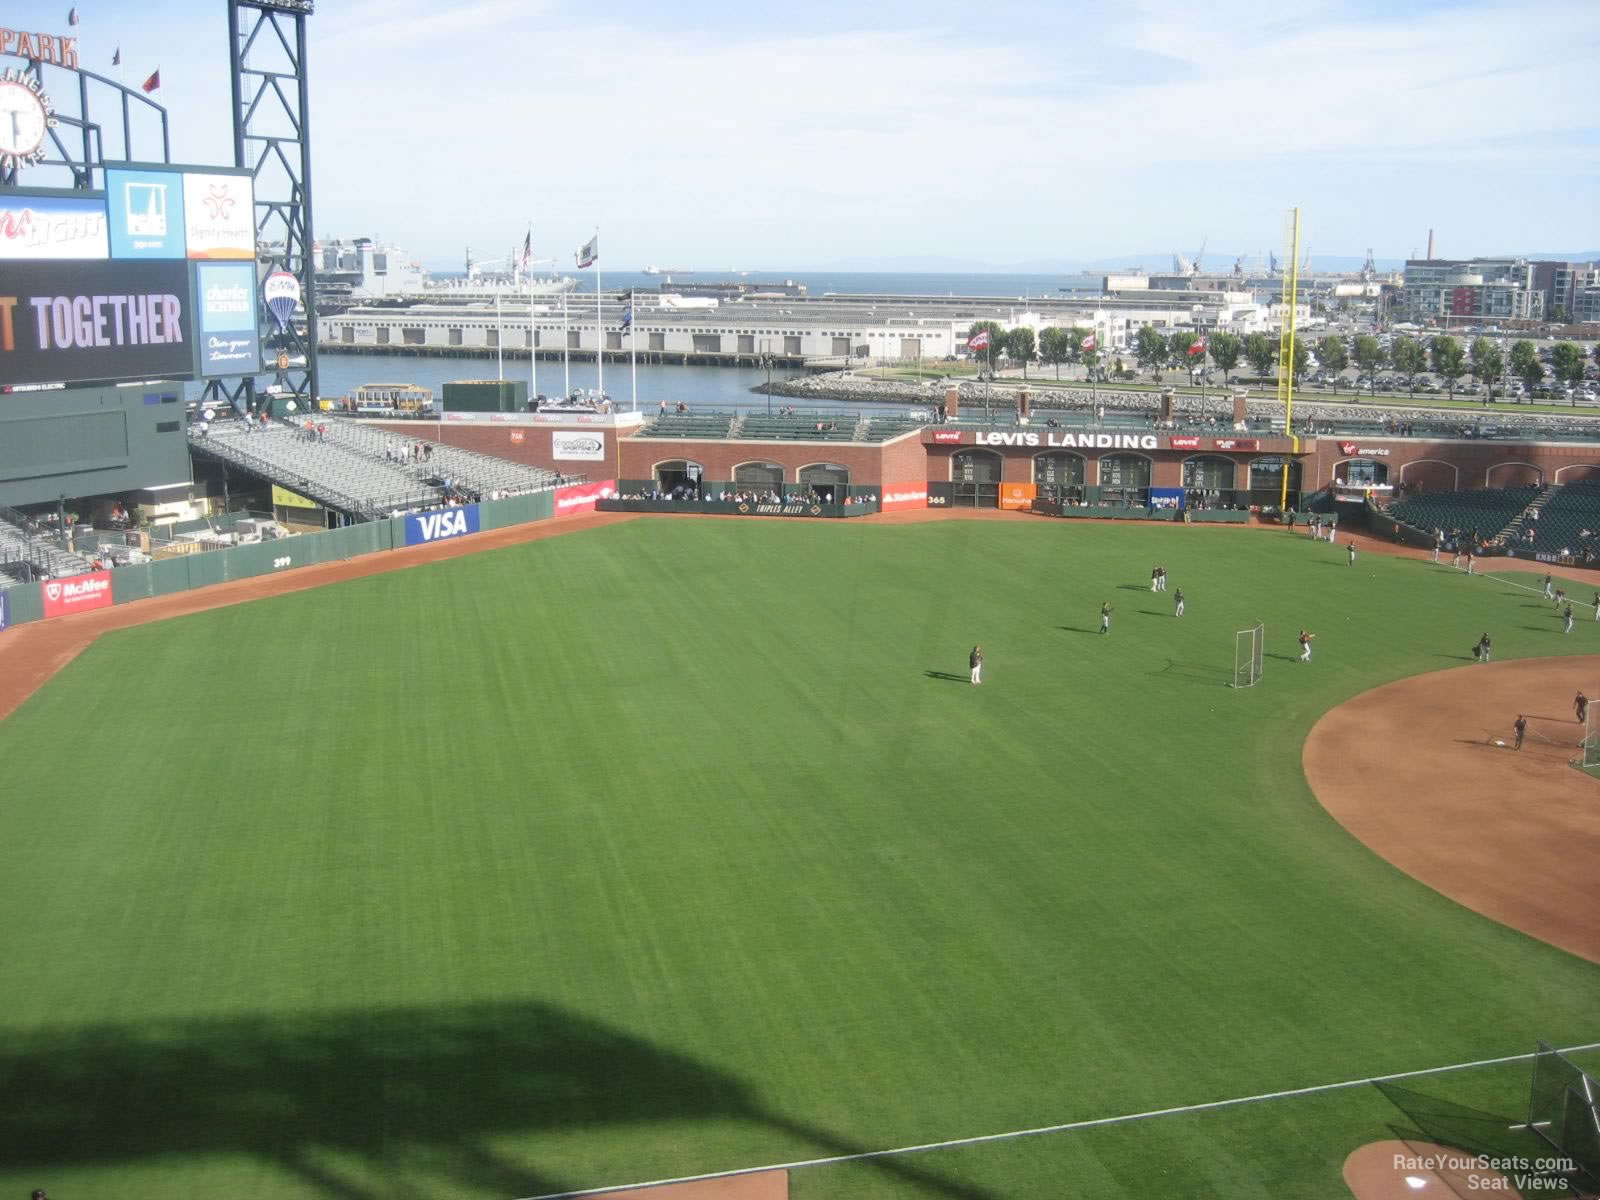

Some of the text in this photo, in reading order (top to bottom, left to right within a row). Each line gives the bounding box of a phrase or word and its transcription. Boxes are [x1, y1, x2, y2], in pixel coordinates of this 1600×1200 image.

[0, 28, 78, 70] PARK
[31, 294, 183, 349] TOGETHER
[1047, 433, 1157, 449] LANDING
[1357, 448, 1389, 456] america
[928, 496, 945, 504] 365
[756, 504, 804, 513] TRIPLES ALLEY
[416, 509, 467, 541] VISA
[274, 556, 291, 568] 399
[64, 579, 109, 596] McAfee
